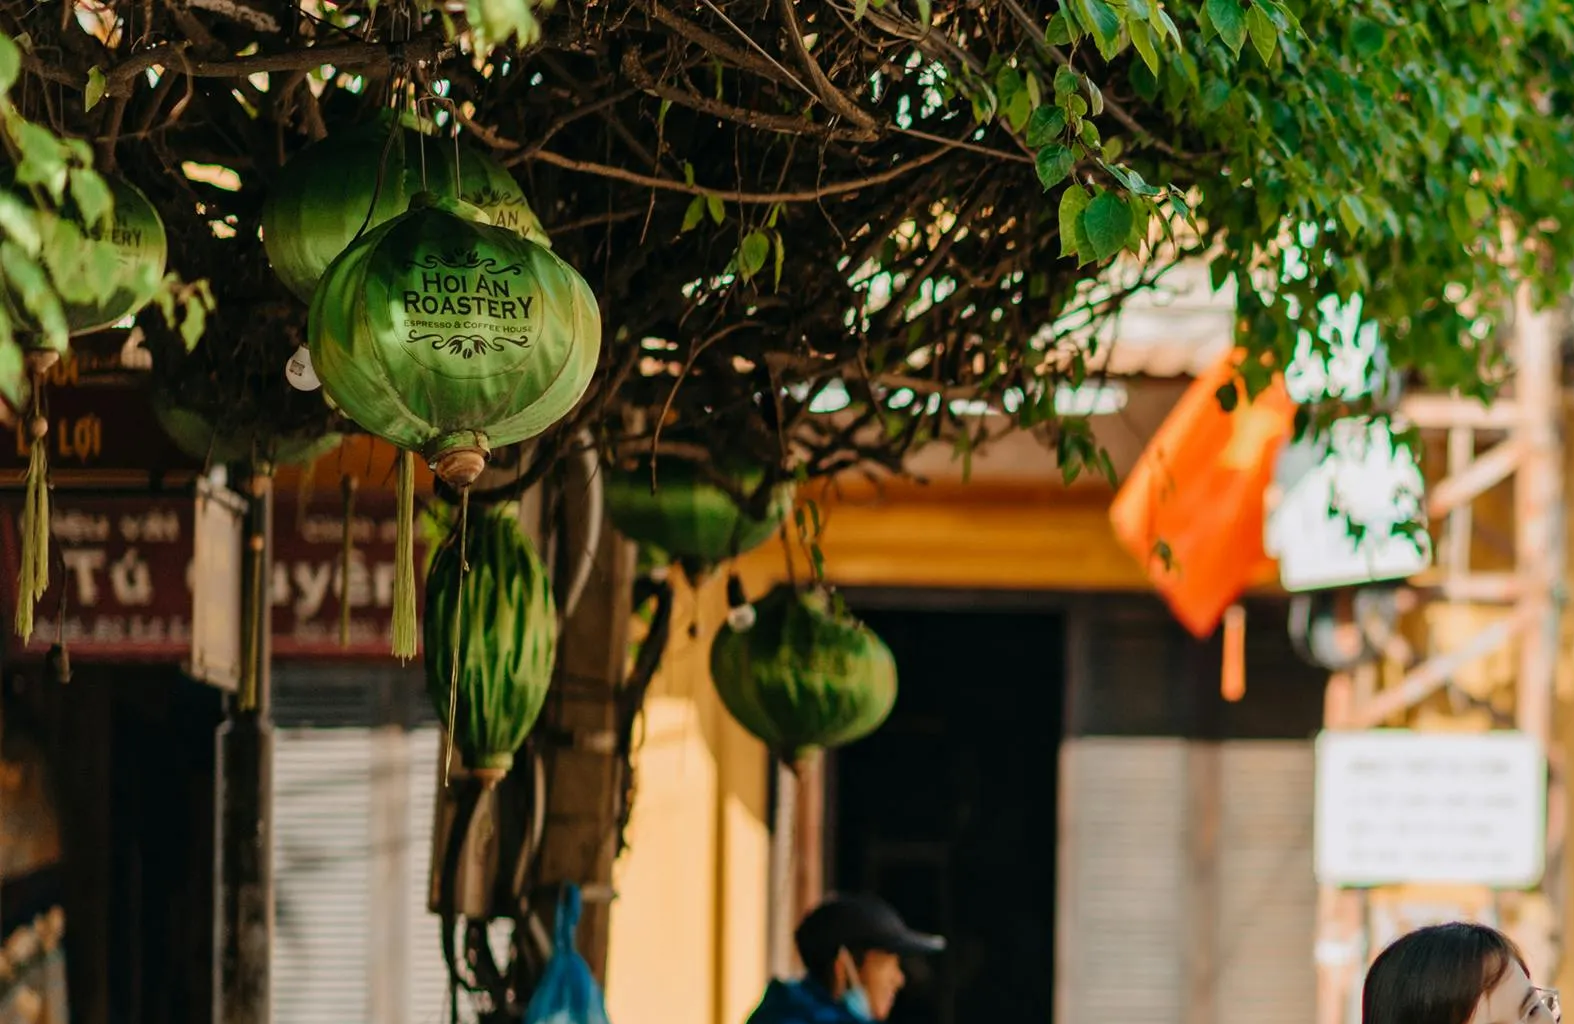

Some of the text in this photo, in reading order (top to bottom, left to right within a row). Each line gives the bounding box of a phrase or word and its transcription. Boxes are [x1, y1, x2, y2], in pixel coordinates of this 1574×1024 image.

[423, 272, 510, 297] HOI AN
[403, 290, 534, 320] ROASTERY
[404, 319, 533, 334] ESPRESSO & COFFEE HOUSE
